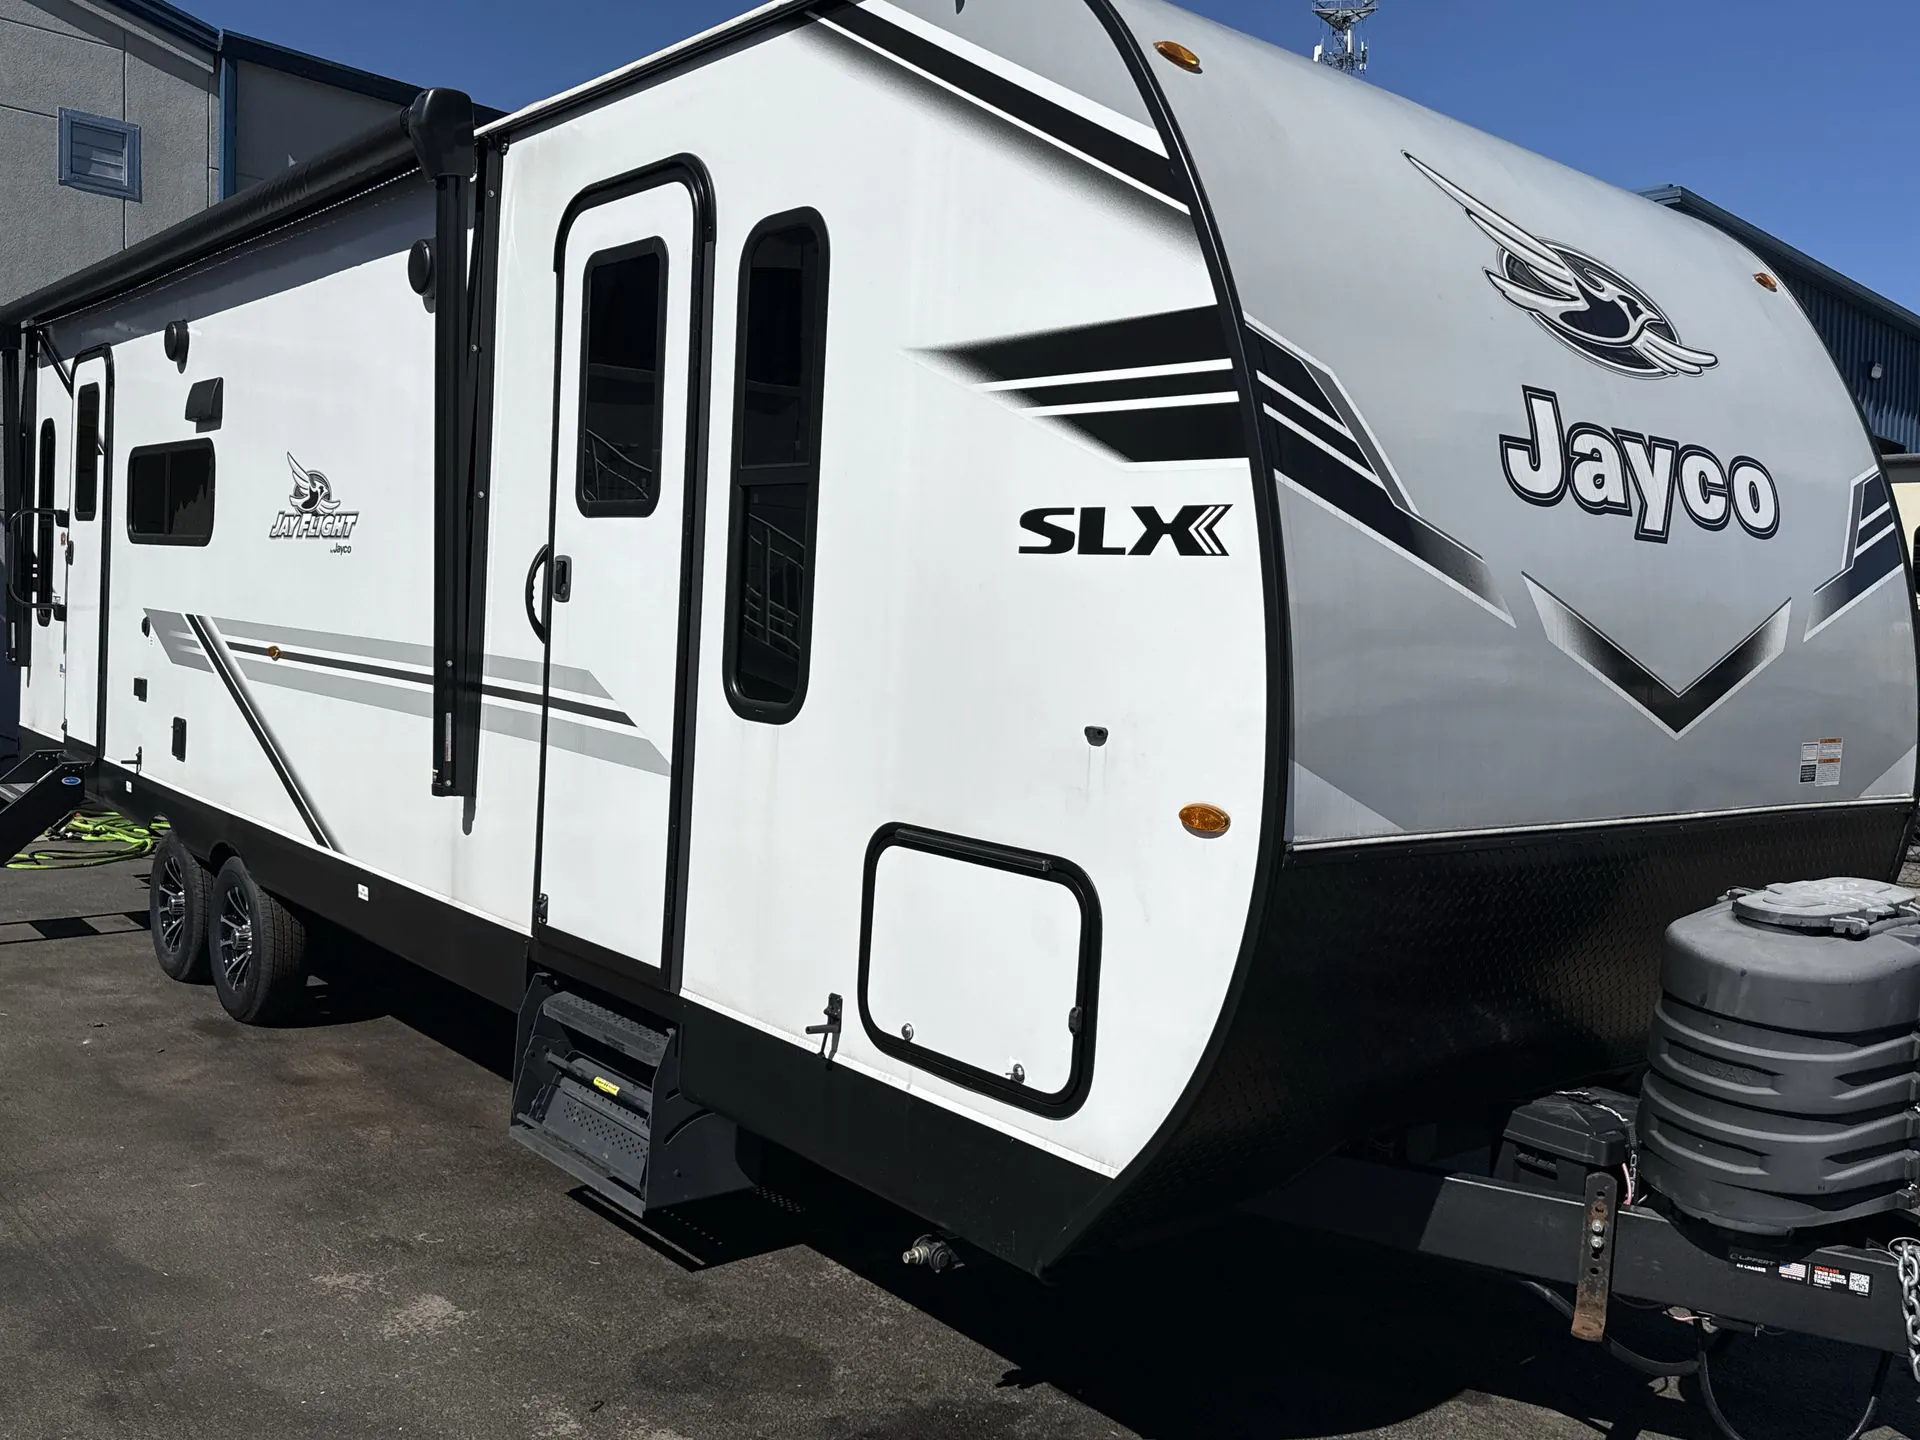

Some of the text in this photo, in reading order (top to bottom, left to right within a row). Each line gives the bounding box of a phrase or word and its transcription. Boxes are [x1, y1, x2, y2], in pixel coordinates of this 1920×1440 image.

[1499, 384, 1780, 544] Jayco
[269, 511, 359, 538] JAY FLIGHT
[1018, 503, 1234, 557] SLX
[333, 542, 352, 555] Jayco
